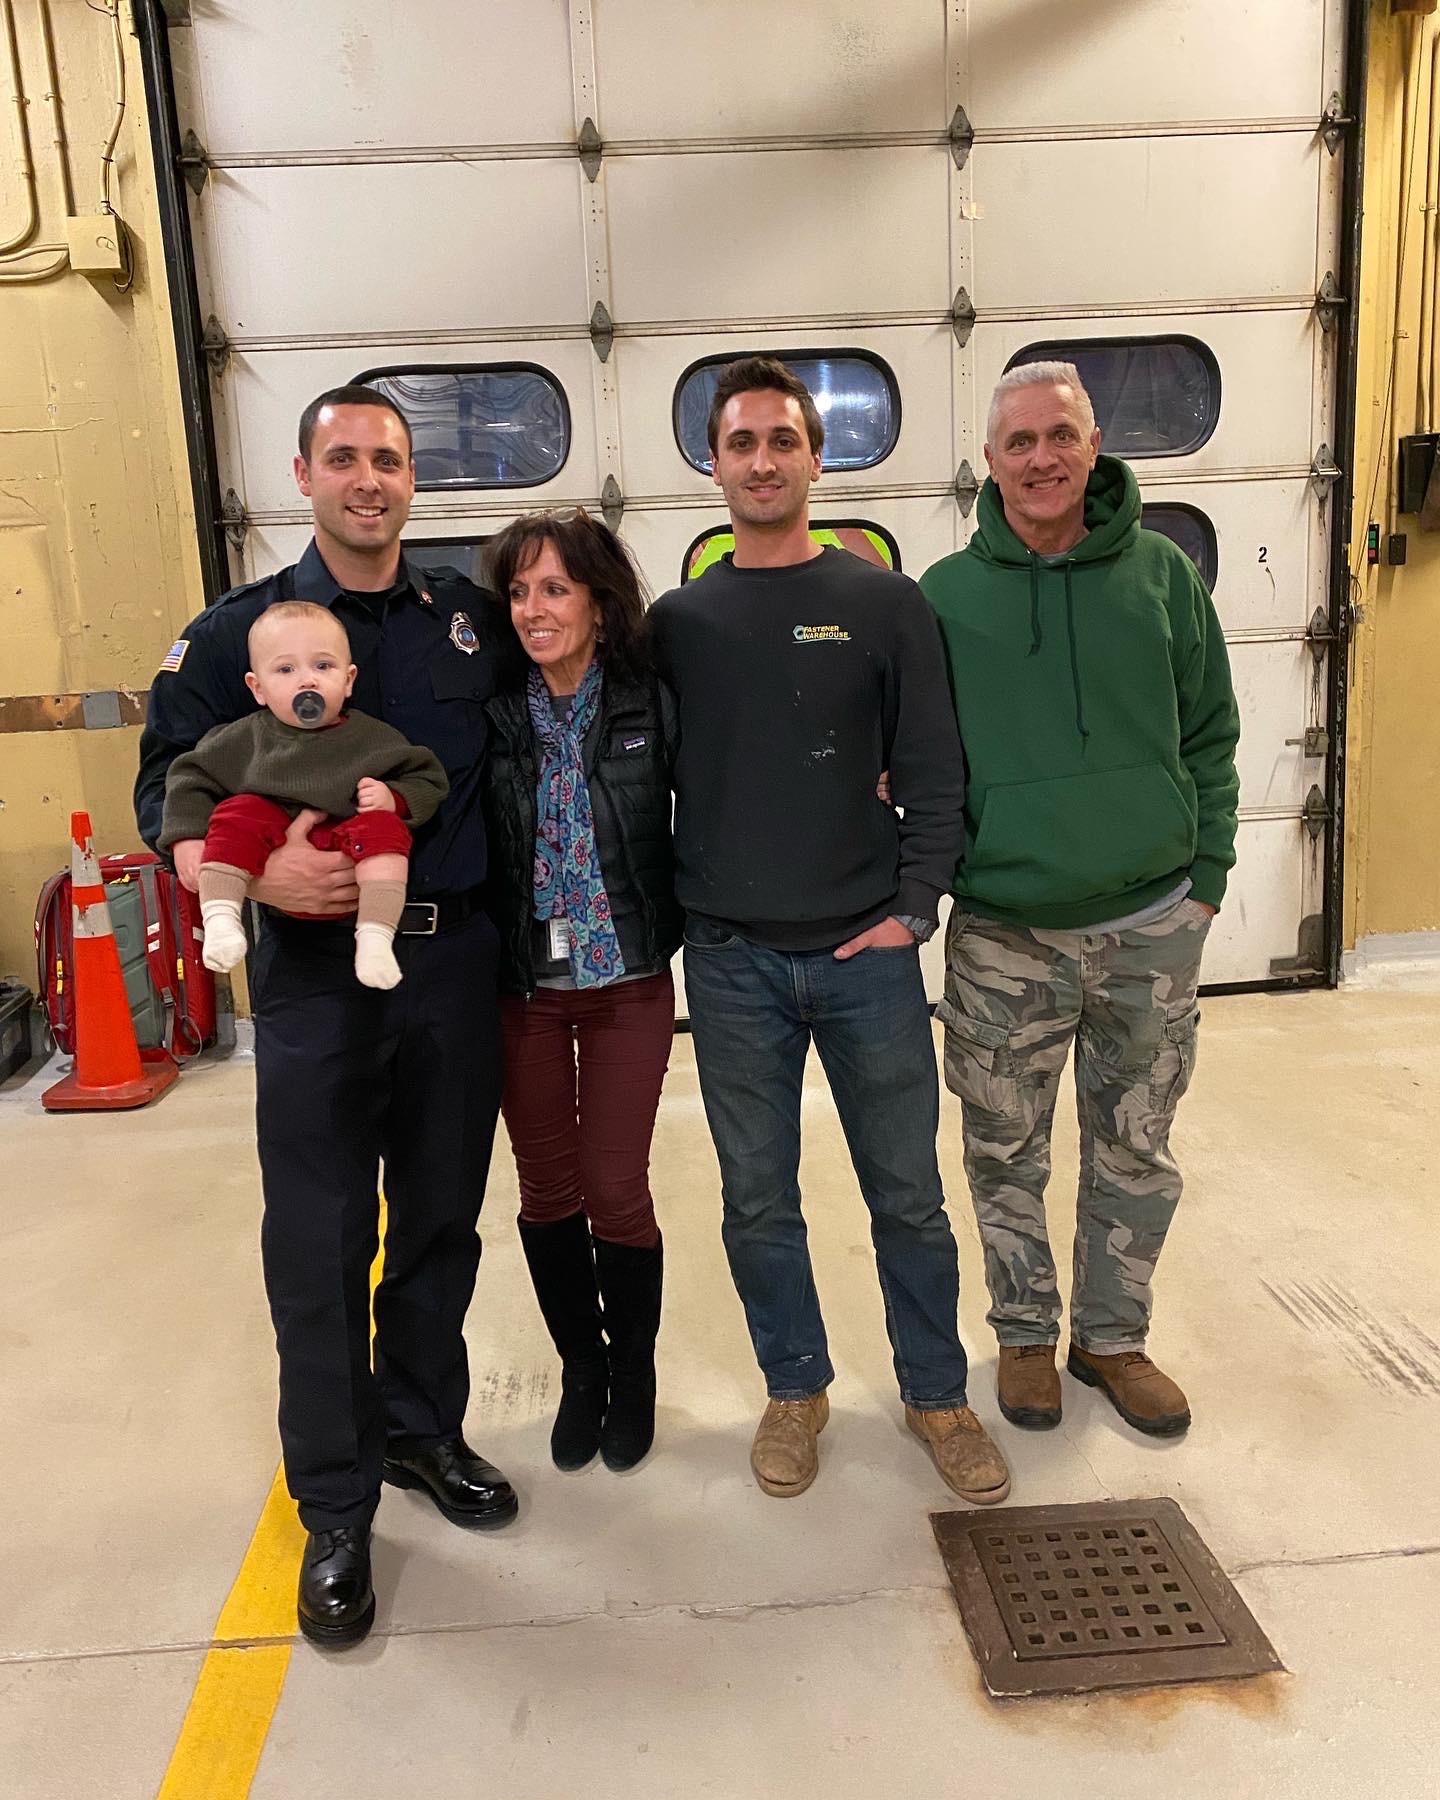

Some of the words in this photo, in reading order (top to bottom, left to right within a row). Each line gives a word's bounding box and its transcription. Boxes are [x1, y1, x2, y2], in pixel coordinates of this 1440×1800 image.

[1258, 546, 1268, 563] 2
[803, 625, 840, 633] FASTENER
[803, 631, 849, 640] WAREHOUSE
